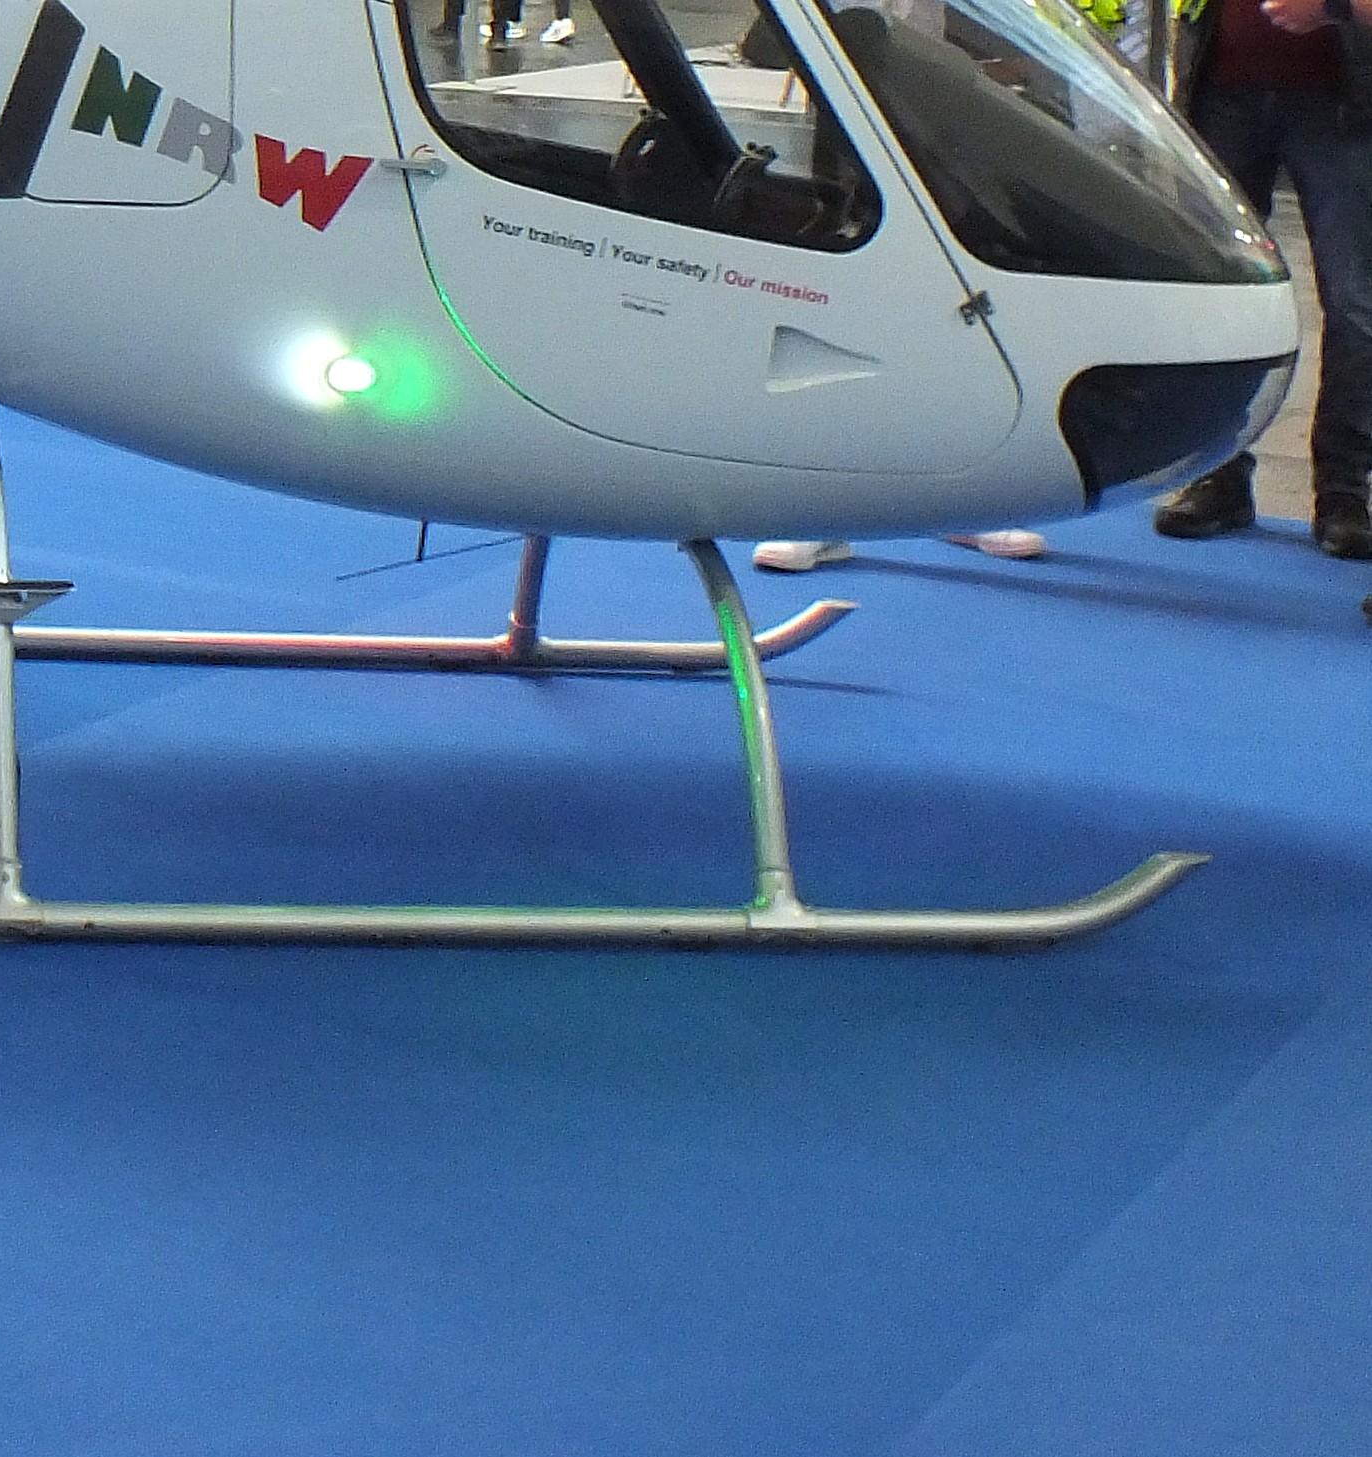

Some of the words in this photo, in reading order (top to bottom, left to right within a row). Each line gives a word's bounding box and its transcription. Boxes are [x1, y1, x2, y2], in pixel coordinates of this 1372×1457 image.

[70, 44, 374, 232] NRW
[483, 214, 523, 236] Your
[528, 226, 596, 257] training
[612, 244, 653, 266] Your
[656, 255, 710, 283] safety
[724, 269, 756, 289] Our
[760, 277, 830, 305] mission
